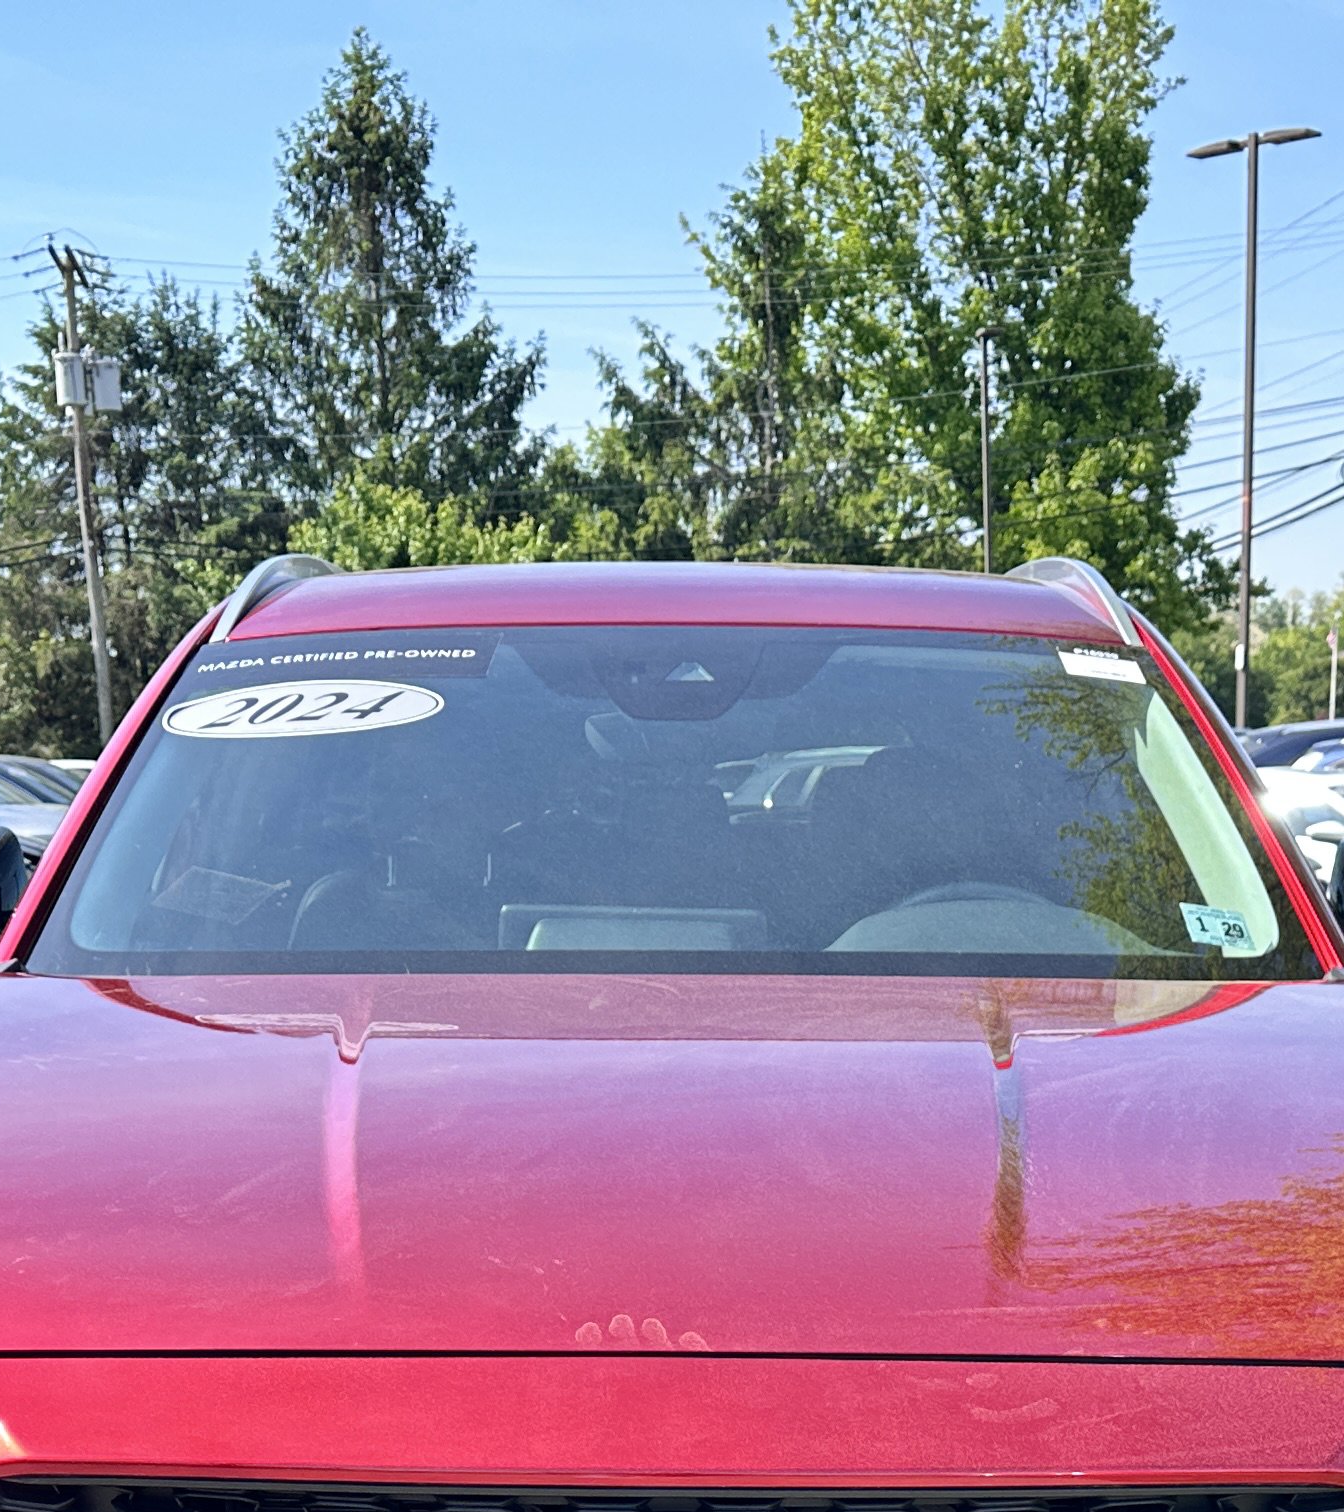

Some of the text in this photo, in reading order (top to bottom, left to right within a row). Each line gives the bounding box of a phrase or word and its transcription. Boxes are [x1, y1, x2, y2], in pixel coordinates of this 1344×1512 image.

[197, 649, 476, 673] MAZDA CERTIFIED PRE-OWNED
[197, 690, 407, 730] 2024
[1195, 916, 1245, 938] 1 29
